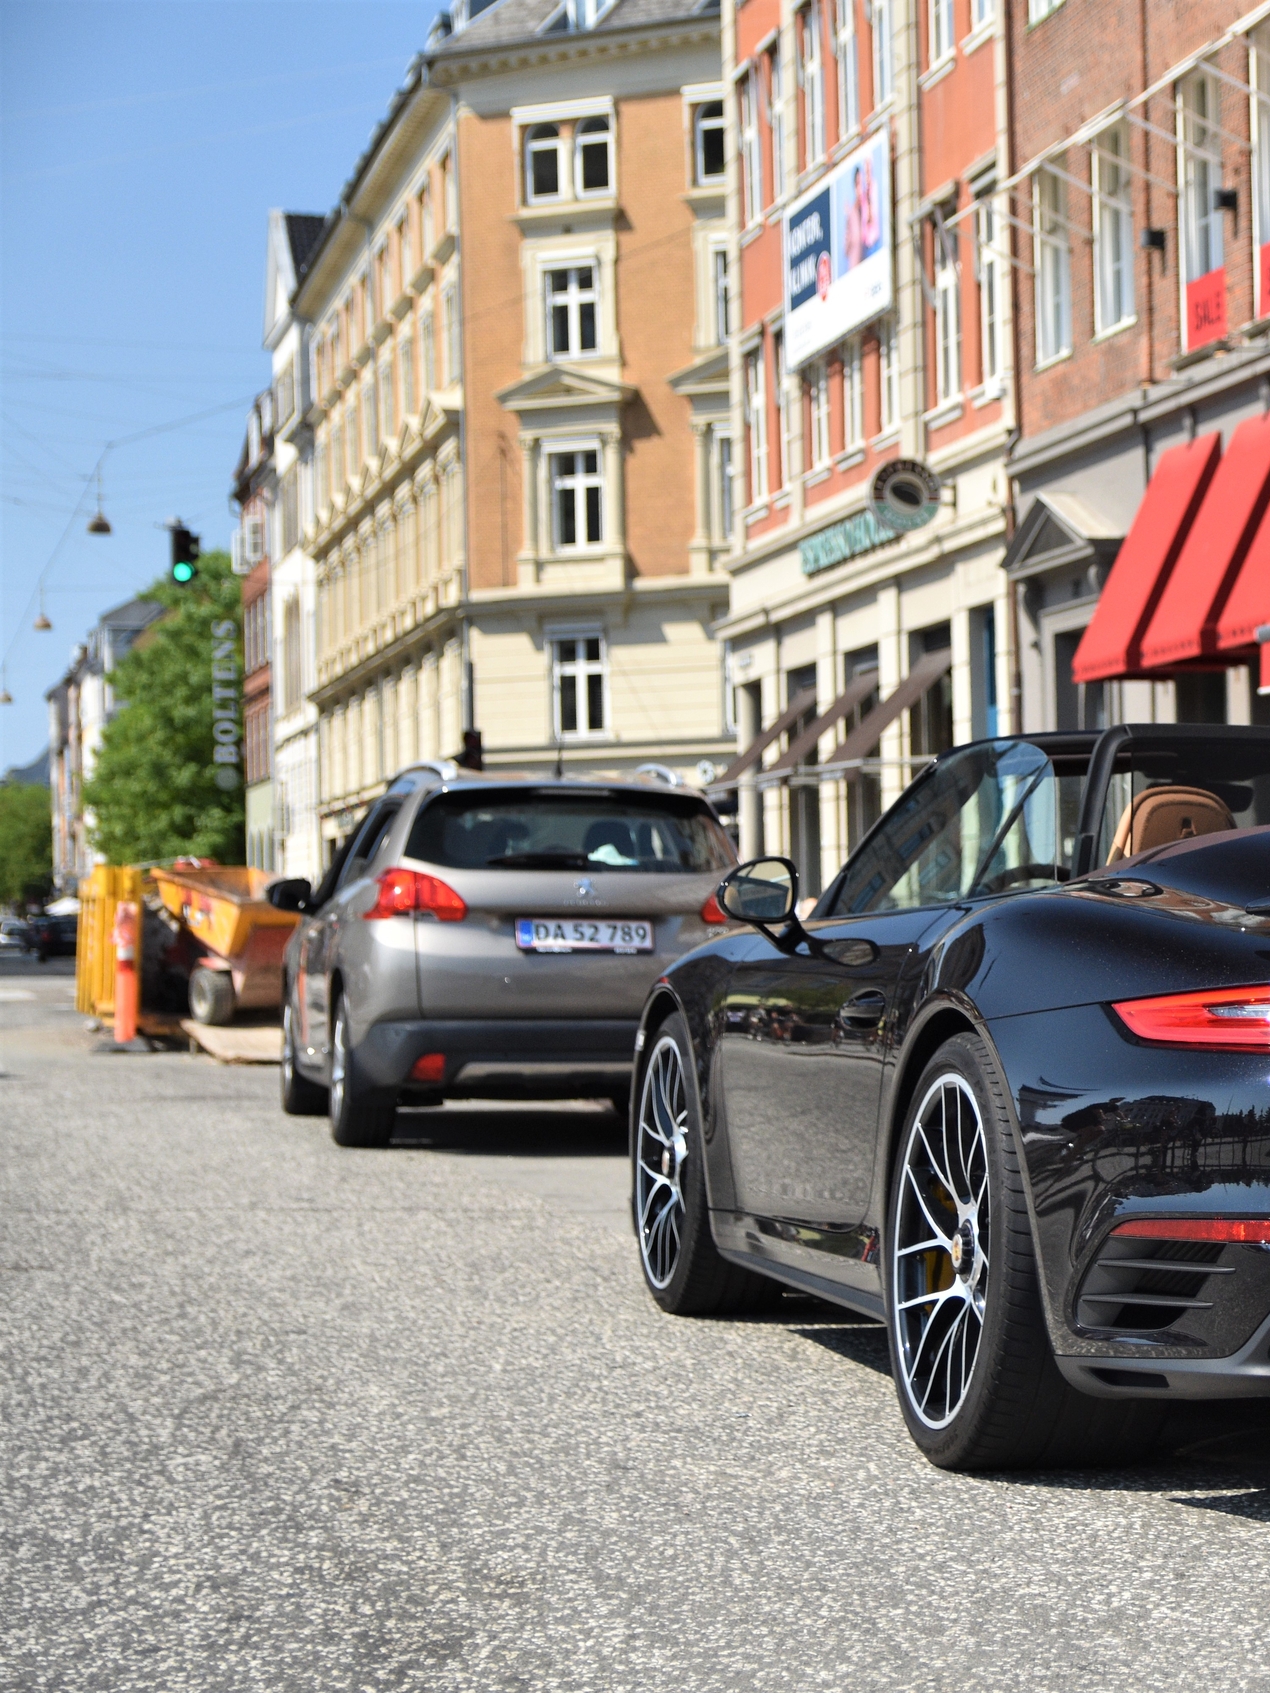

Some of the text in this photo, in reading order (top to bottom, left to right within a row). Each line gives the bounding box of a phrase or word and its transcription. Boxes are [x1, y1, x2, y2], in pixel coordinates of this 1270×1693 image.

[1194, 290, 1222, 331] SALE
[211, 619, 238, 764] BOLTENS
[535, 923, 647, 944] DA 52 789
